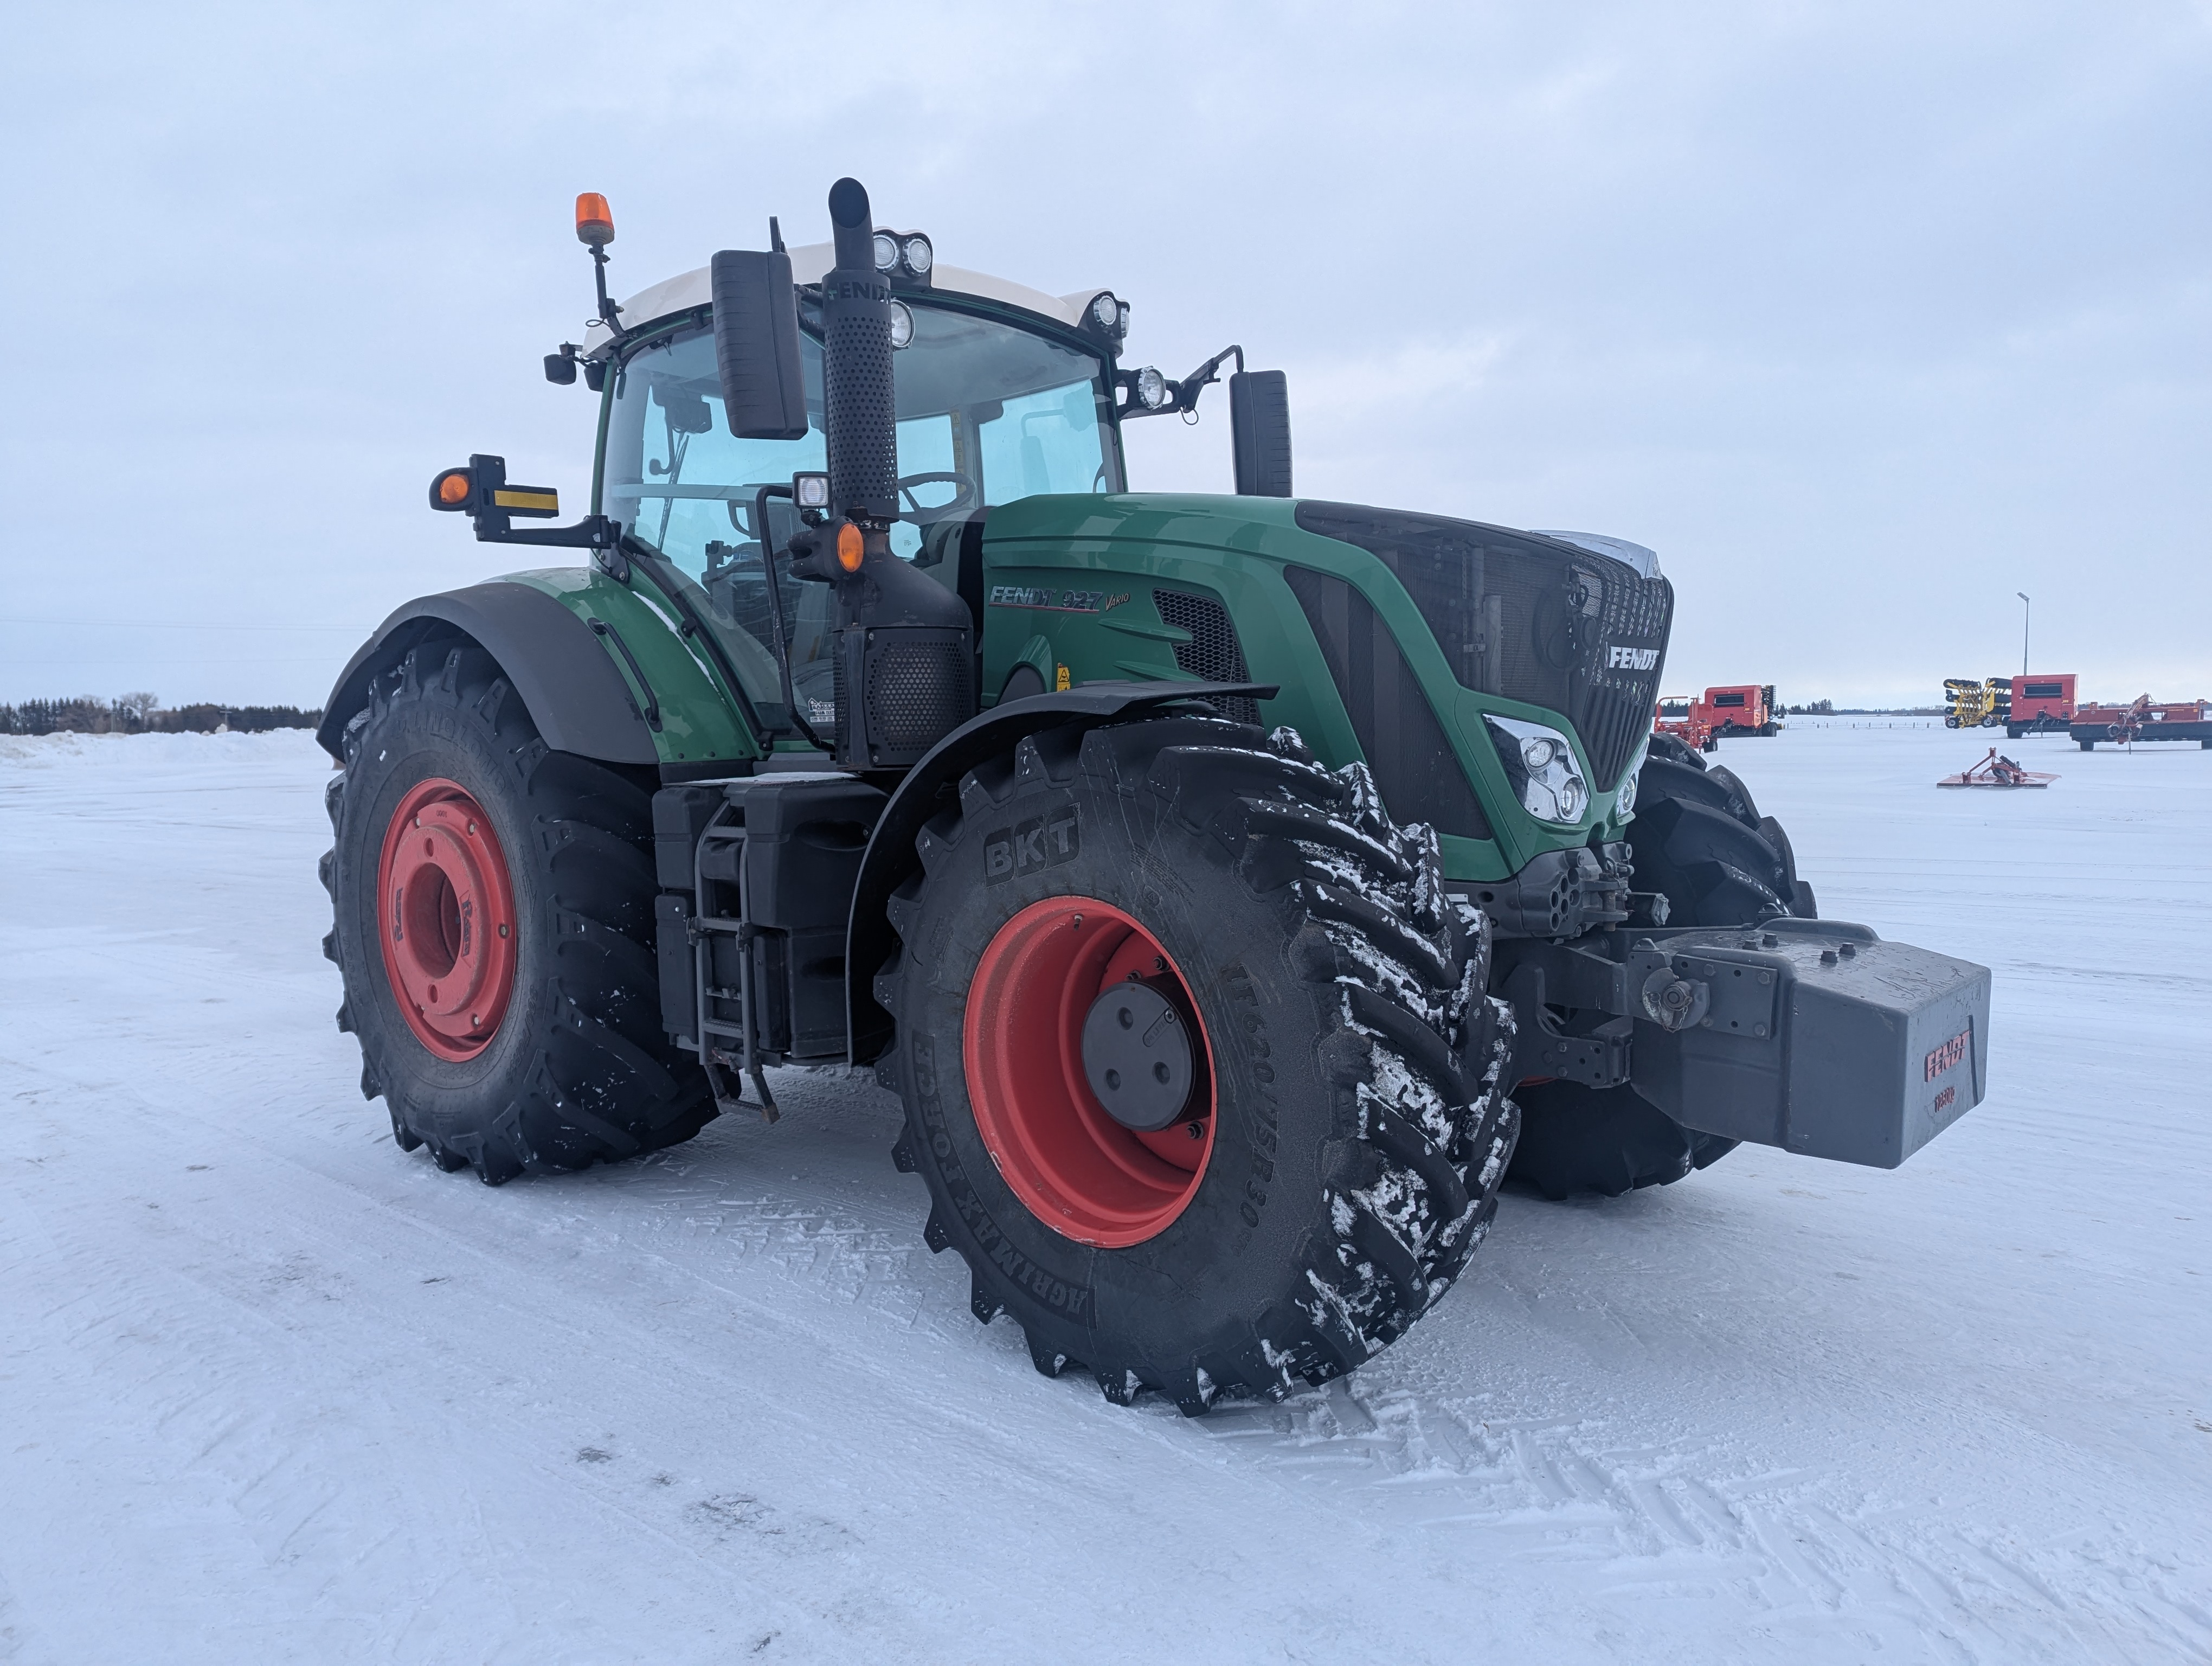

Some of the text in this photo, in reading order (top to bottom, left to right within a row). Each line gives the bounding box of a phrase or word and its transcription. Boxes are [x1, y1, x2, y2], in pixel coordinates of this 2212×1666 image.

[826, 281, 891, 305] FENDT
[989, 586, 1057, 607] FENDT
[1062, 591, 1103, 611] 927
[1609, 646, 1660, 670] FENDT
[985, 817, 1076, 878] BKT
[1924, 1029, 1971, 1082] FENDT
